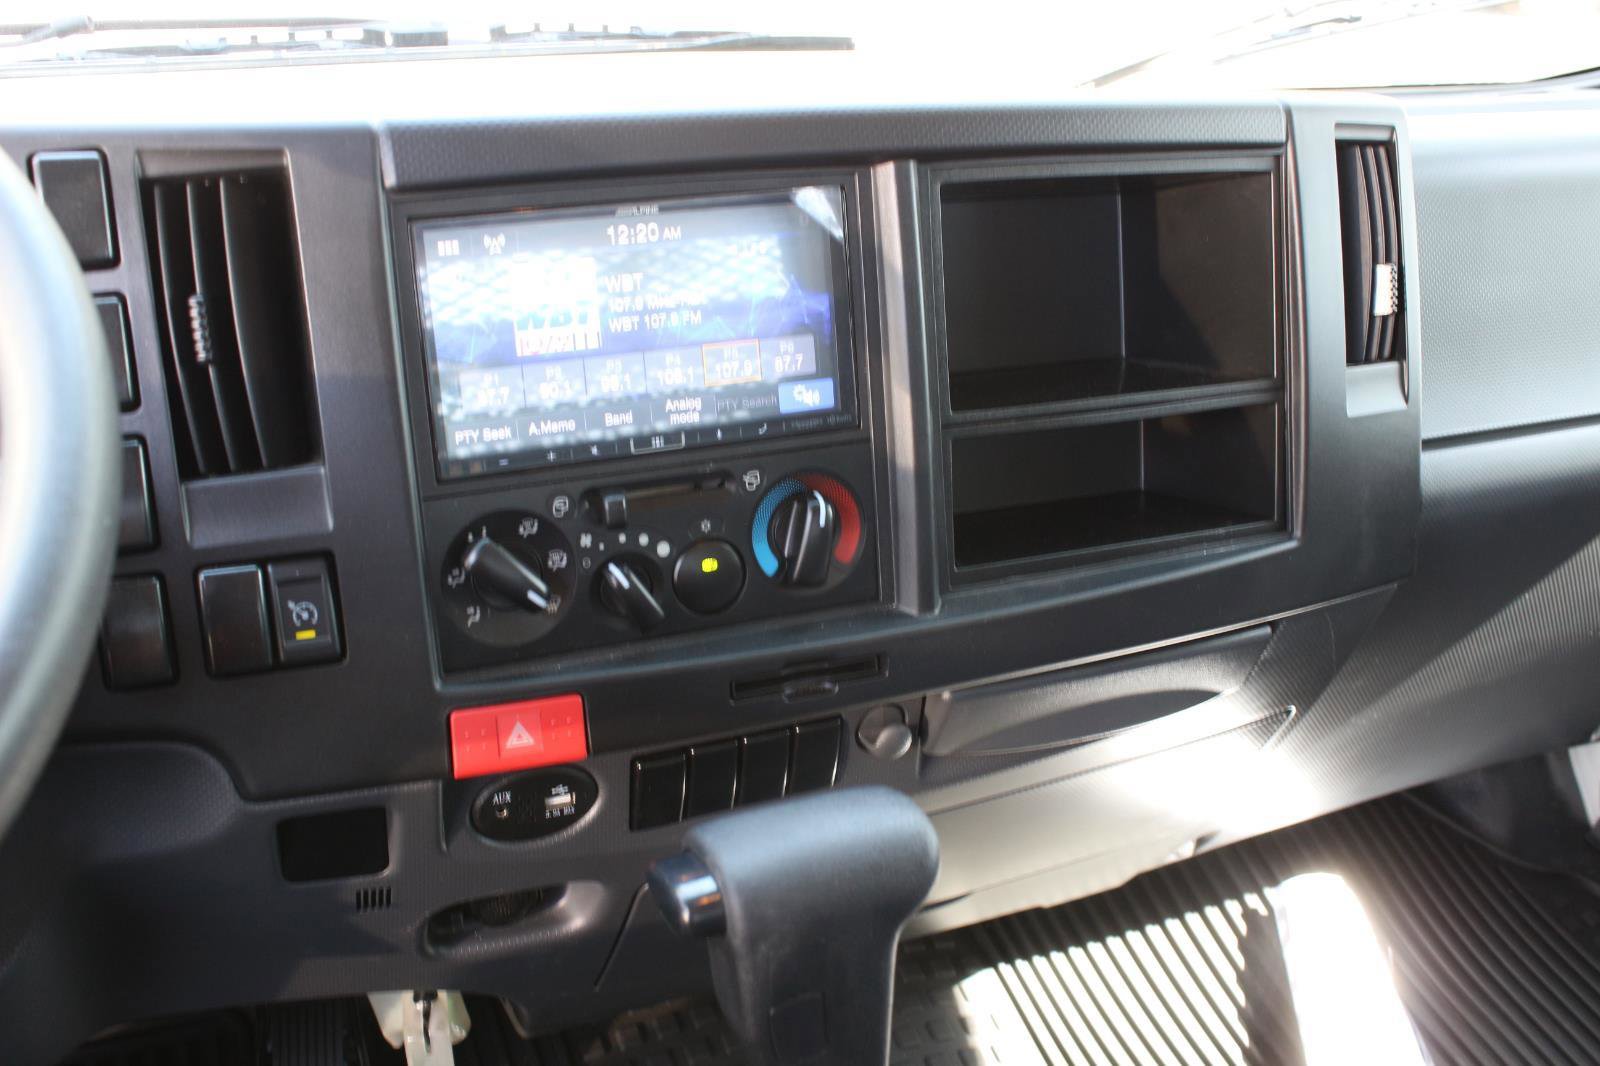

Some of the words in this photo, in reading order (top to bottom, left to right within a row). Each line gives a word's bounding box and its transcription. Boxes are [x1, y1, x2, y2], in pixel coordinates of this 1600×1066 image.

[607, 222, 660, 245] 12:20
[662, 226, 682, 241] AM
[605, 272, 644, 293] WBT
[608, 315, 641, 333] WBT
[682, 310, 702, 326] FM
[665, 395, 702, 414] Analog
[604, 410, 633, 427] Band
[669, 409, 700, 426] mode
[455, 428, 480, 446] PTY
[482, 424, 513, 442] Seek
[528, 418, 576, 437] A.Memo
[493, 790, 511, 805] AUX
